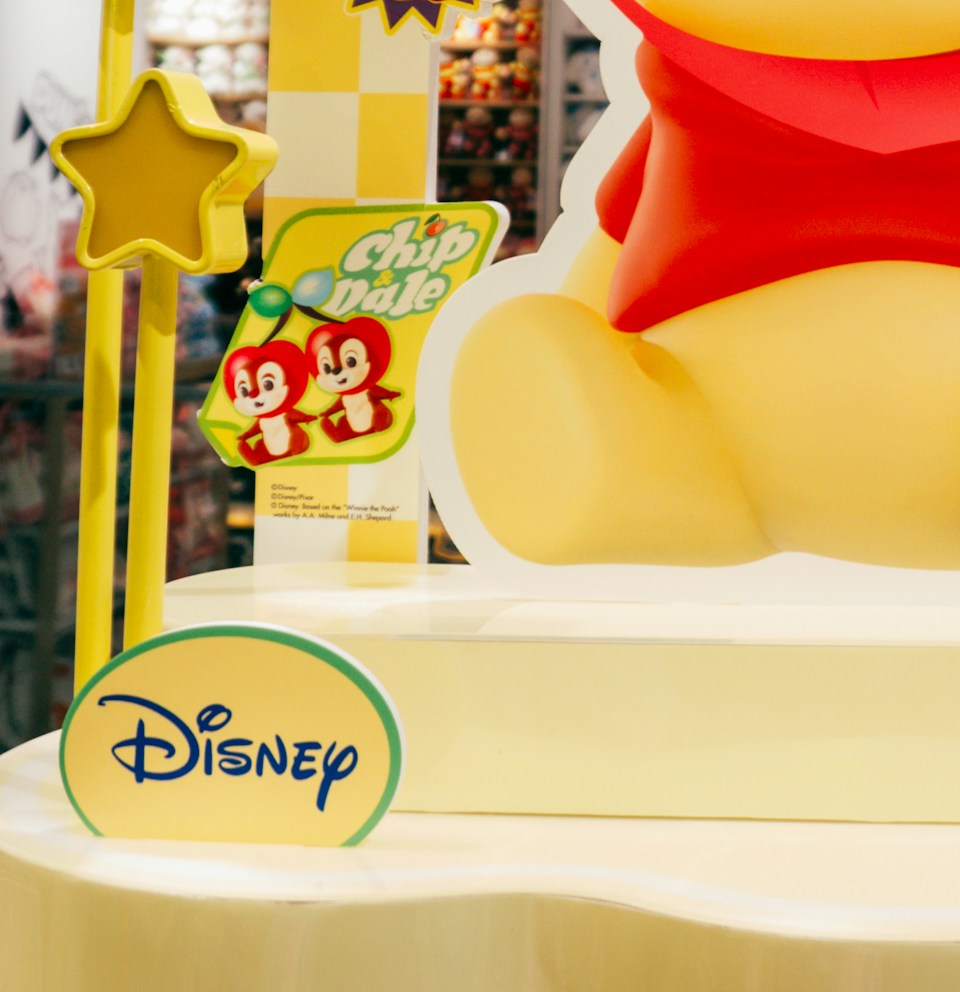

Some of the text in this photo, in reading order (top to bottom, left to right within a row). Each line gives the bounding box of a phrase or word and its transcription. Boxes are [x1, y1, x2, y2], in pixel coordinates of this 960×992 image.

[342, 219, 477, 273] Chip
[322, 269, 447, 317] Dale
[331, 503, 341, 511] the
[370, 504, 379, 512] the
